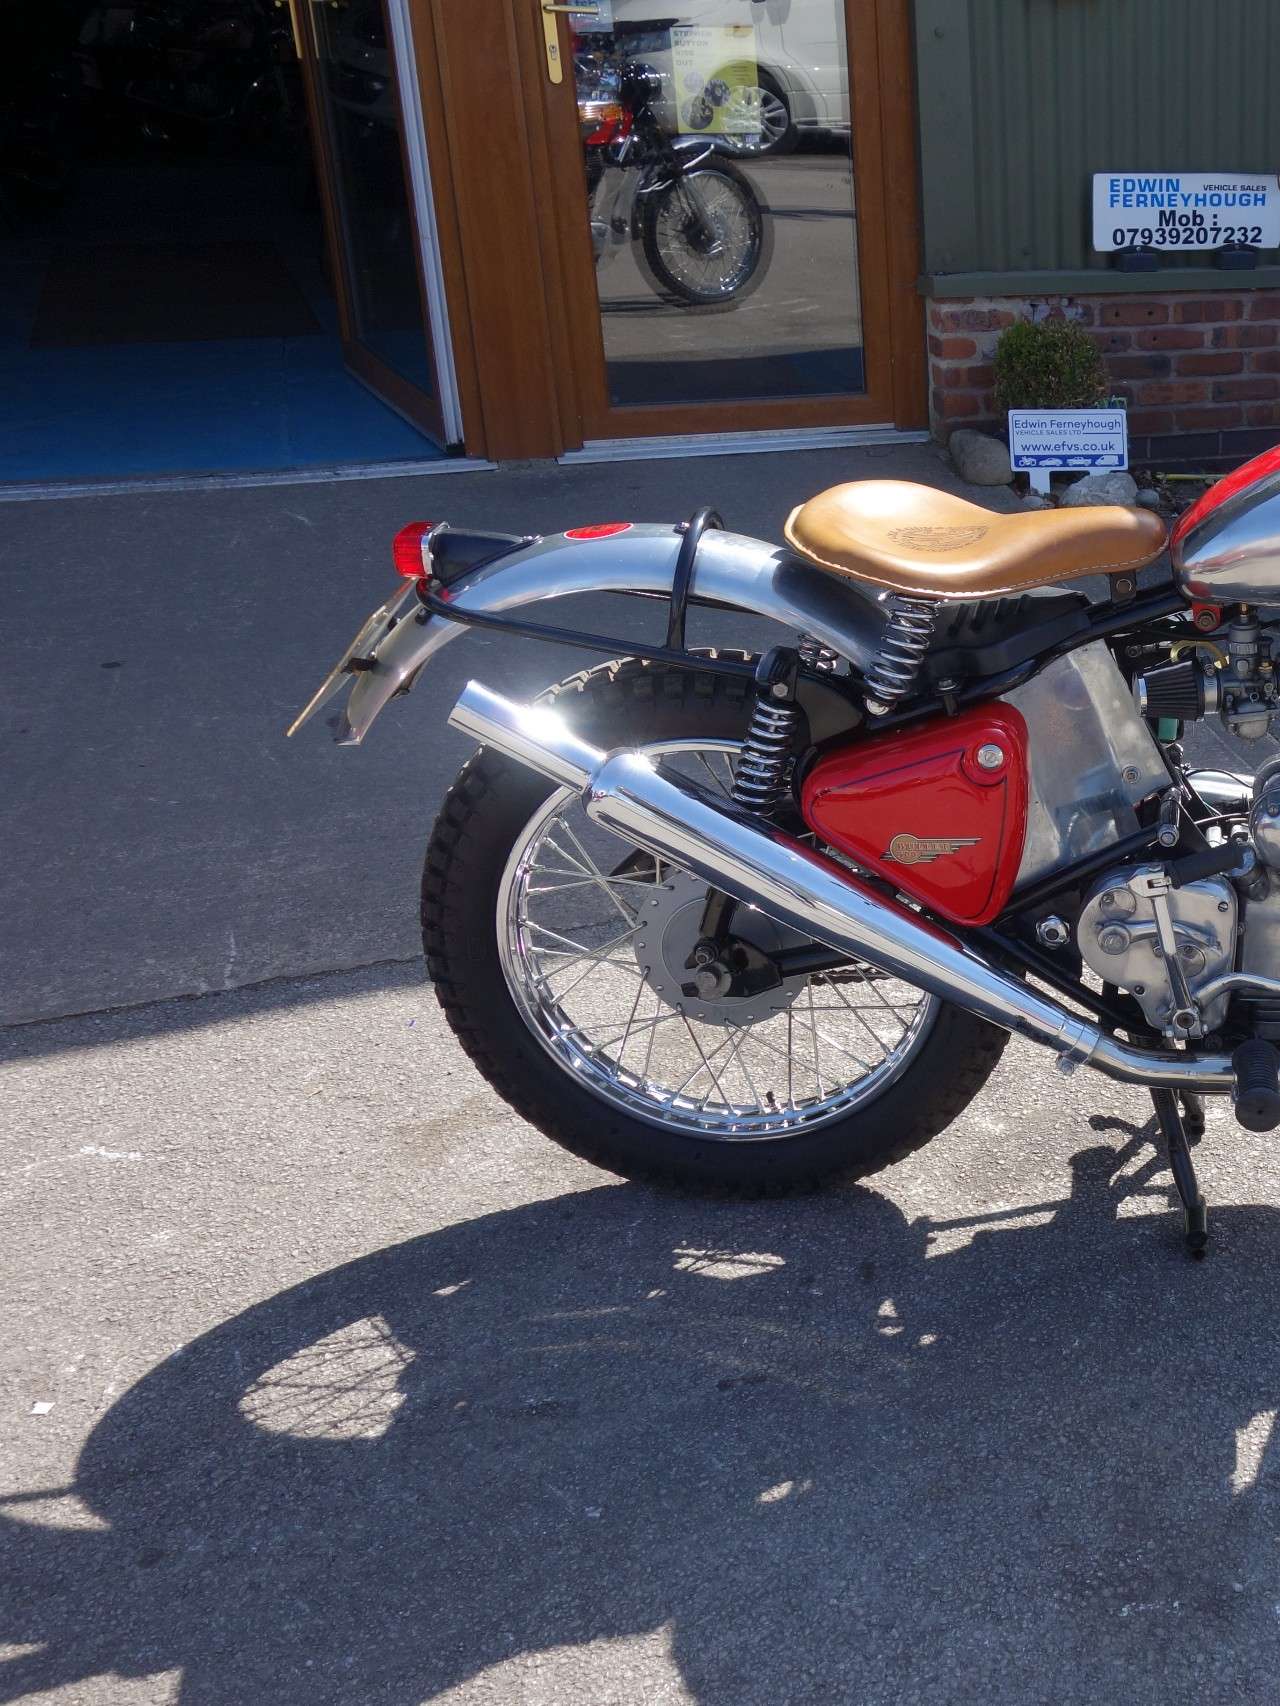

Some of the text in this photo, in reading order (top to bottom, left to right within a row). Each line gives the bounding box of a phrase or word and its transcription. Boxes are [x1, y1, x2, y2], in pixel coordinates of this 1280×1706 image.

[1109, 178, 1180, 192] EDWIN
[1110, 193, 1266, 207] FERNEYHOUGH
[1112, 226, 1262, 245] 07939207232
[1014, 419, 1120, 430] Edwin Ferneyhough
[1021, 441, 1115, 452] www.efvs.co.uk
